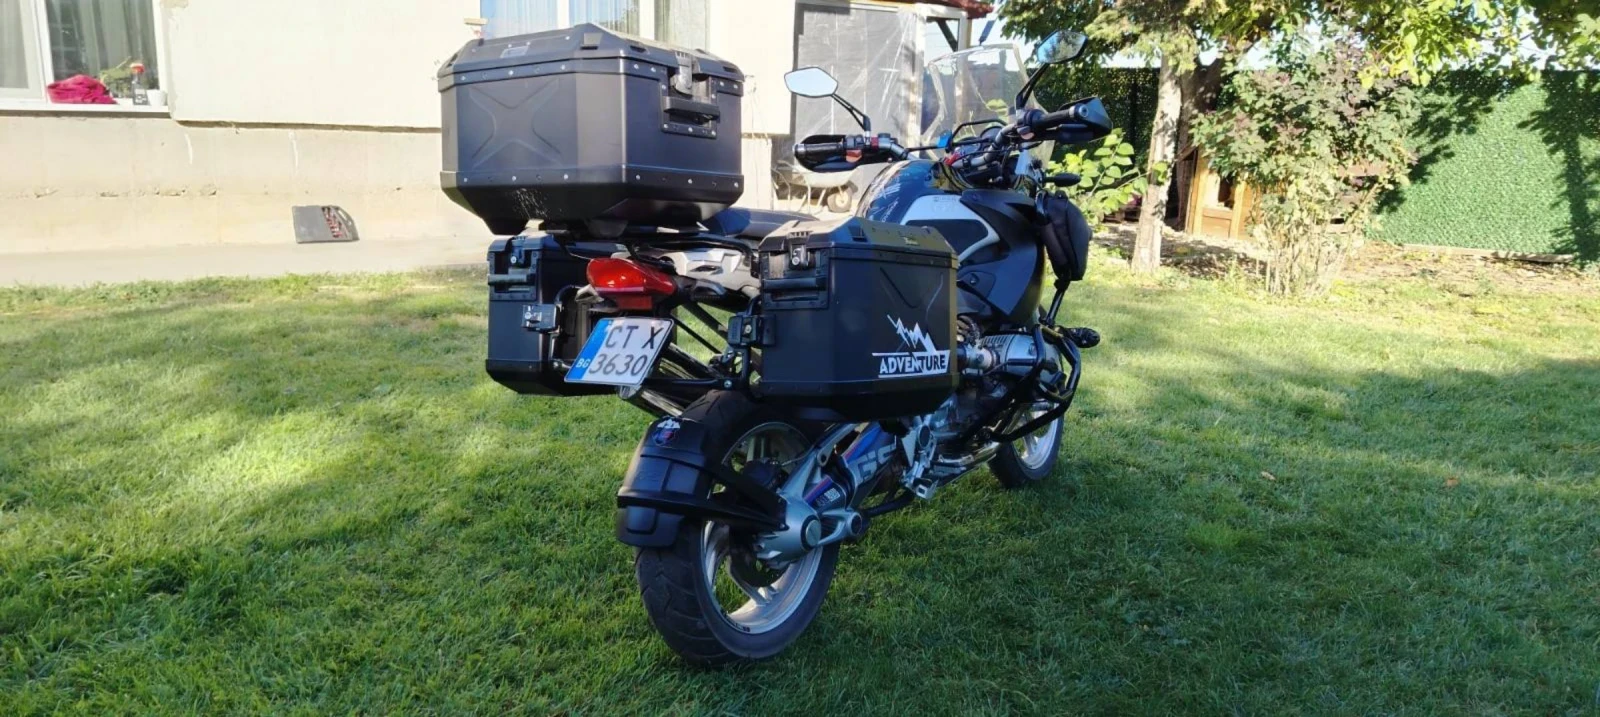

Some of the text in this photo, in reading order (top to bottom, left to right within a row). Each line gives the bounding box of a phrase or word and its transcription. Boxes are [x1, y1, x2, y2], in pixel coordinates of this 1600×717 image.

[605, 325, 664, 350] CT X
[576, 358, 591, 368] BG
[588, 353, 648, 376] 3630
[880, 354, 947, 374] ADVENTURE
